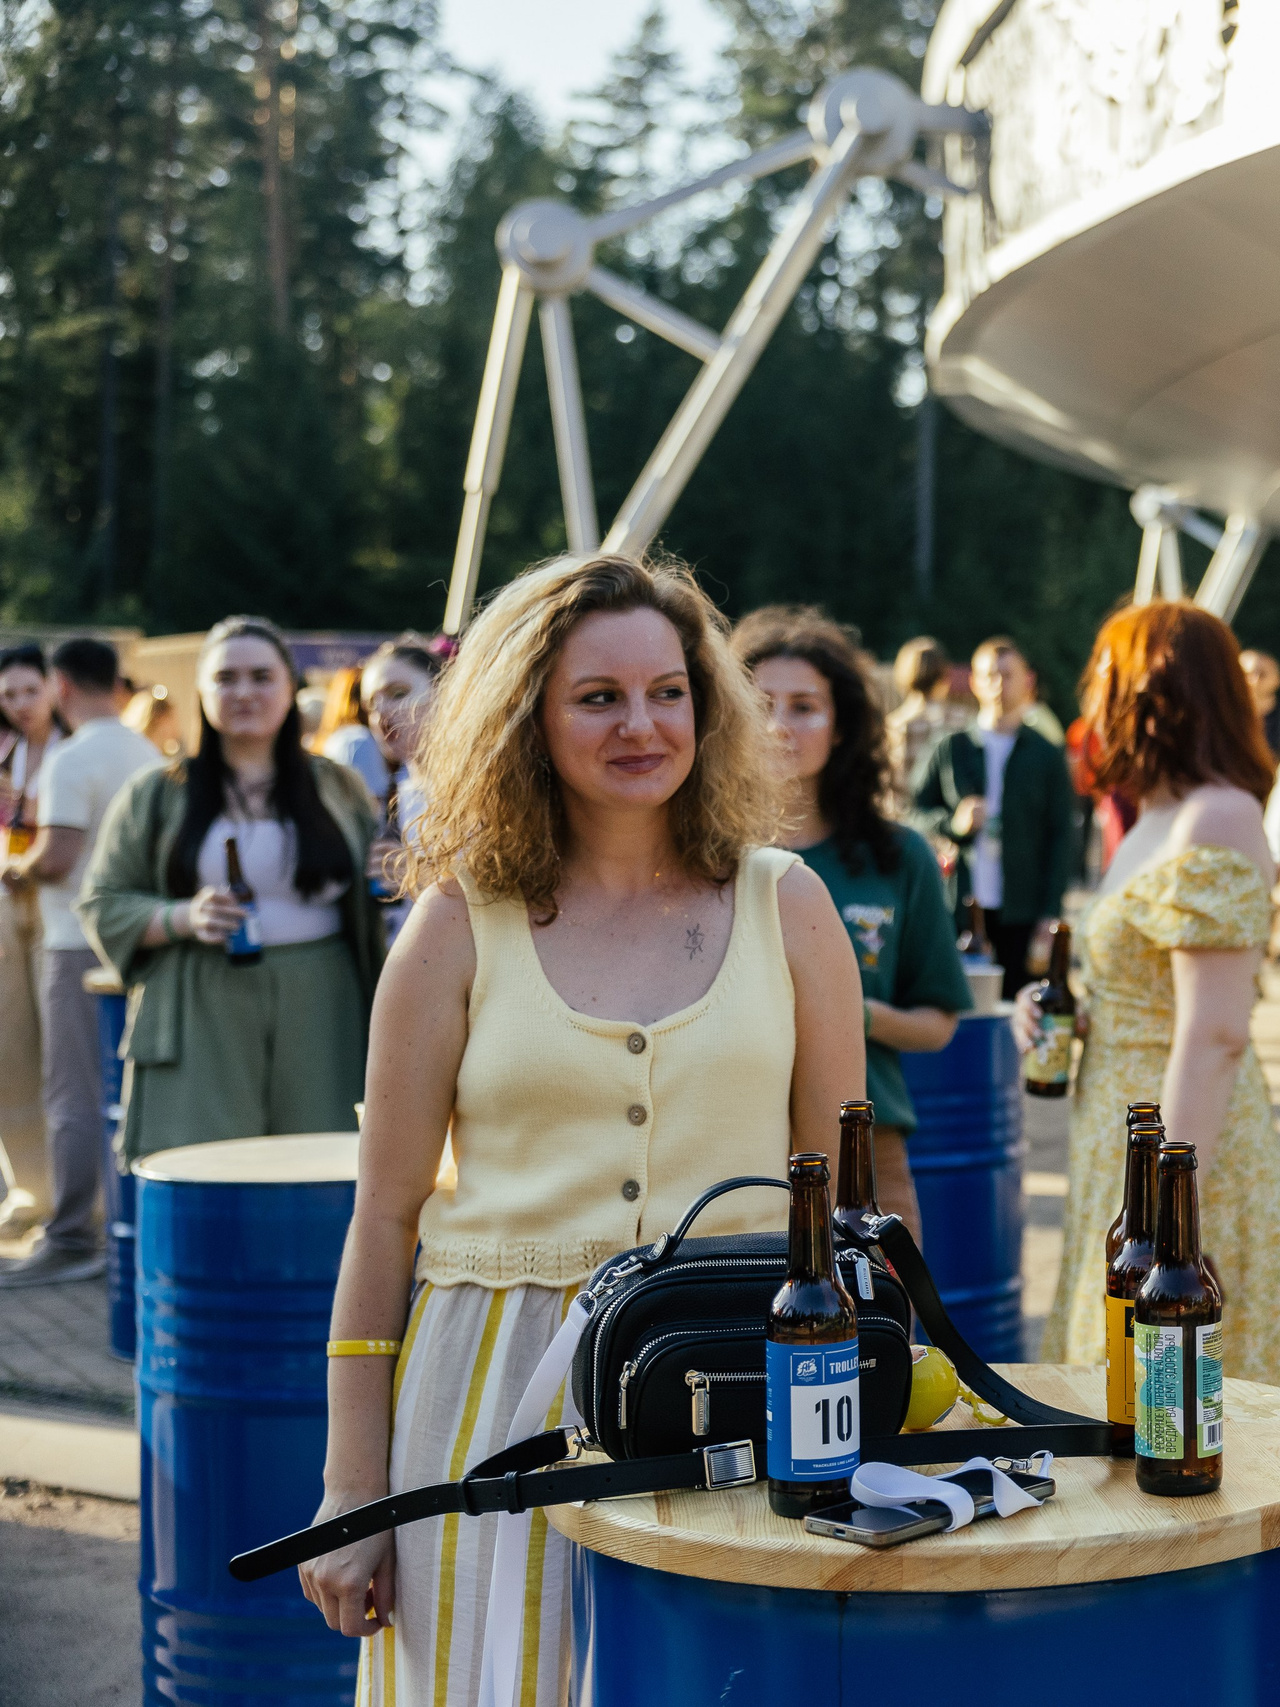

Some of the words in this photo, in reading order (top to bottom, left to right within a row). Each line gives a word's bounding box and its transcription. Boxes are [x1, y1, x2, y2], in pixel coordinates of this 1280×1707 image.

[1154, 1333, 1164, 1366] АЛКОГОЛЯ
[1165, 1334, 1176, 1379] ЗДОРОВЬЮ
[1154, 1366, 1165, 1412] УПОТРЕБЛЕНИЕ
[1165, 1382, 1176, 1418] ВАШЕМУ
[815, 1395, 852, 1445] 10
[1154, 1412, 1165, 1452] ЧРЕЗМЕРНОЕ
[1165, 1420, 1177, 1453] ВРЕДИТ
